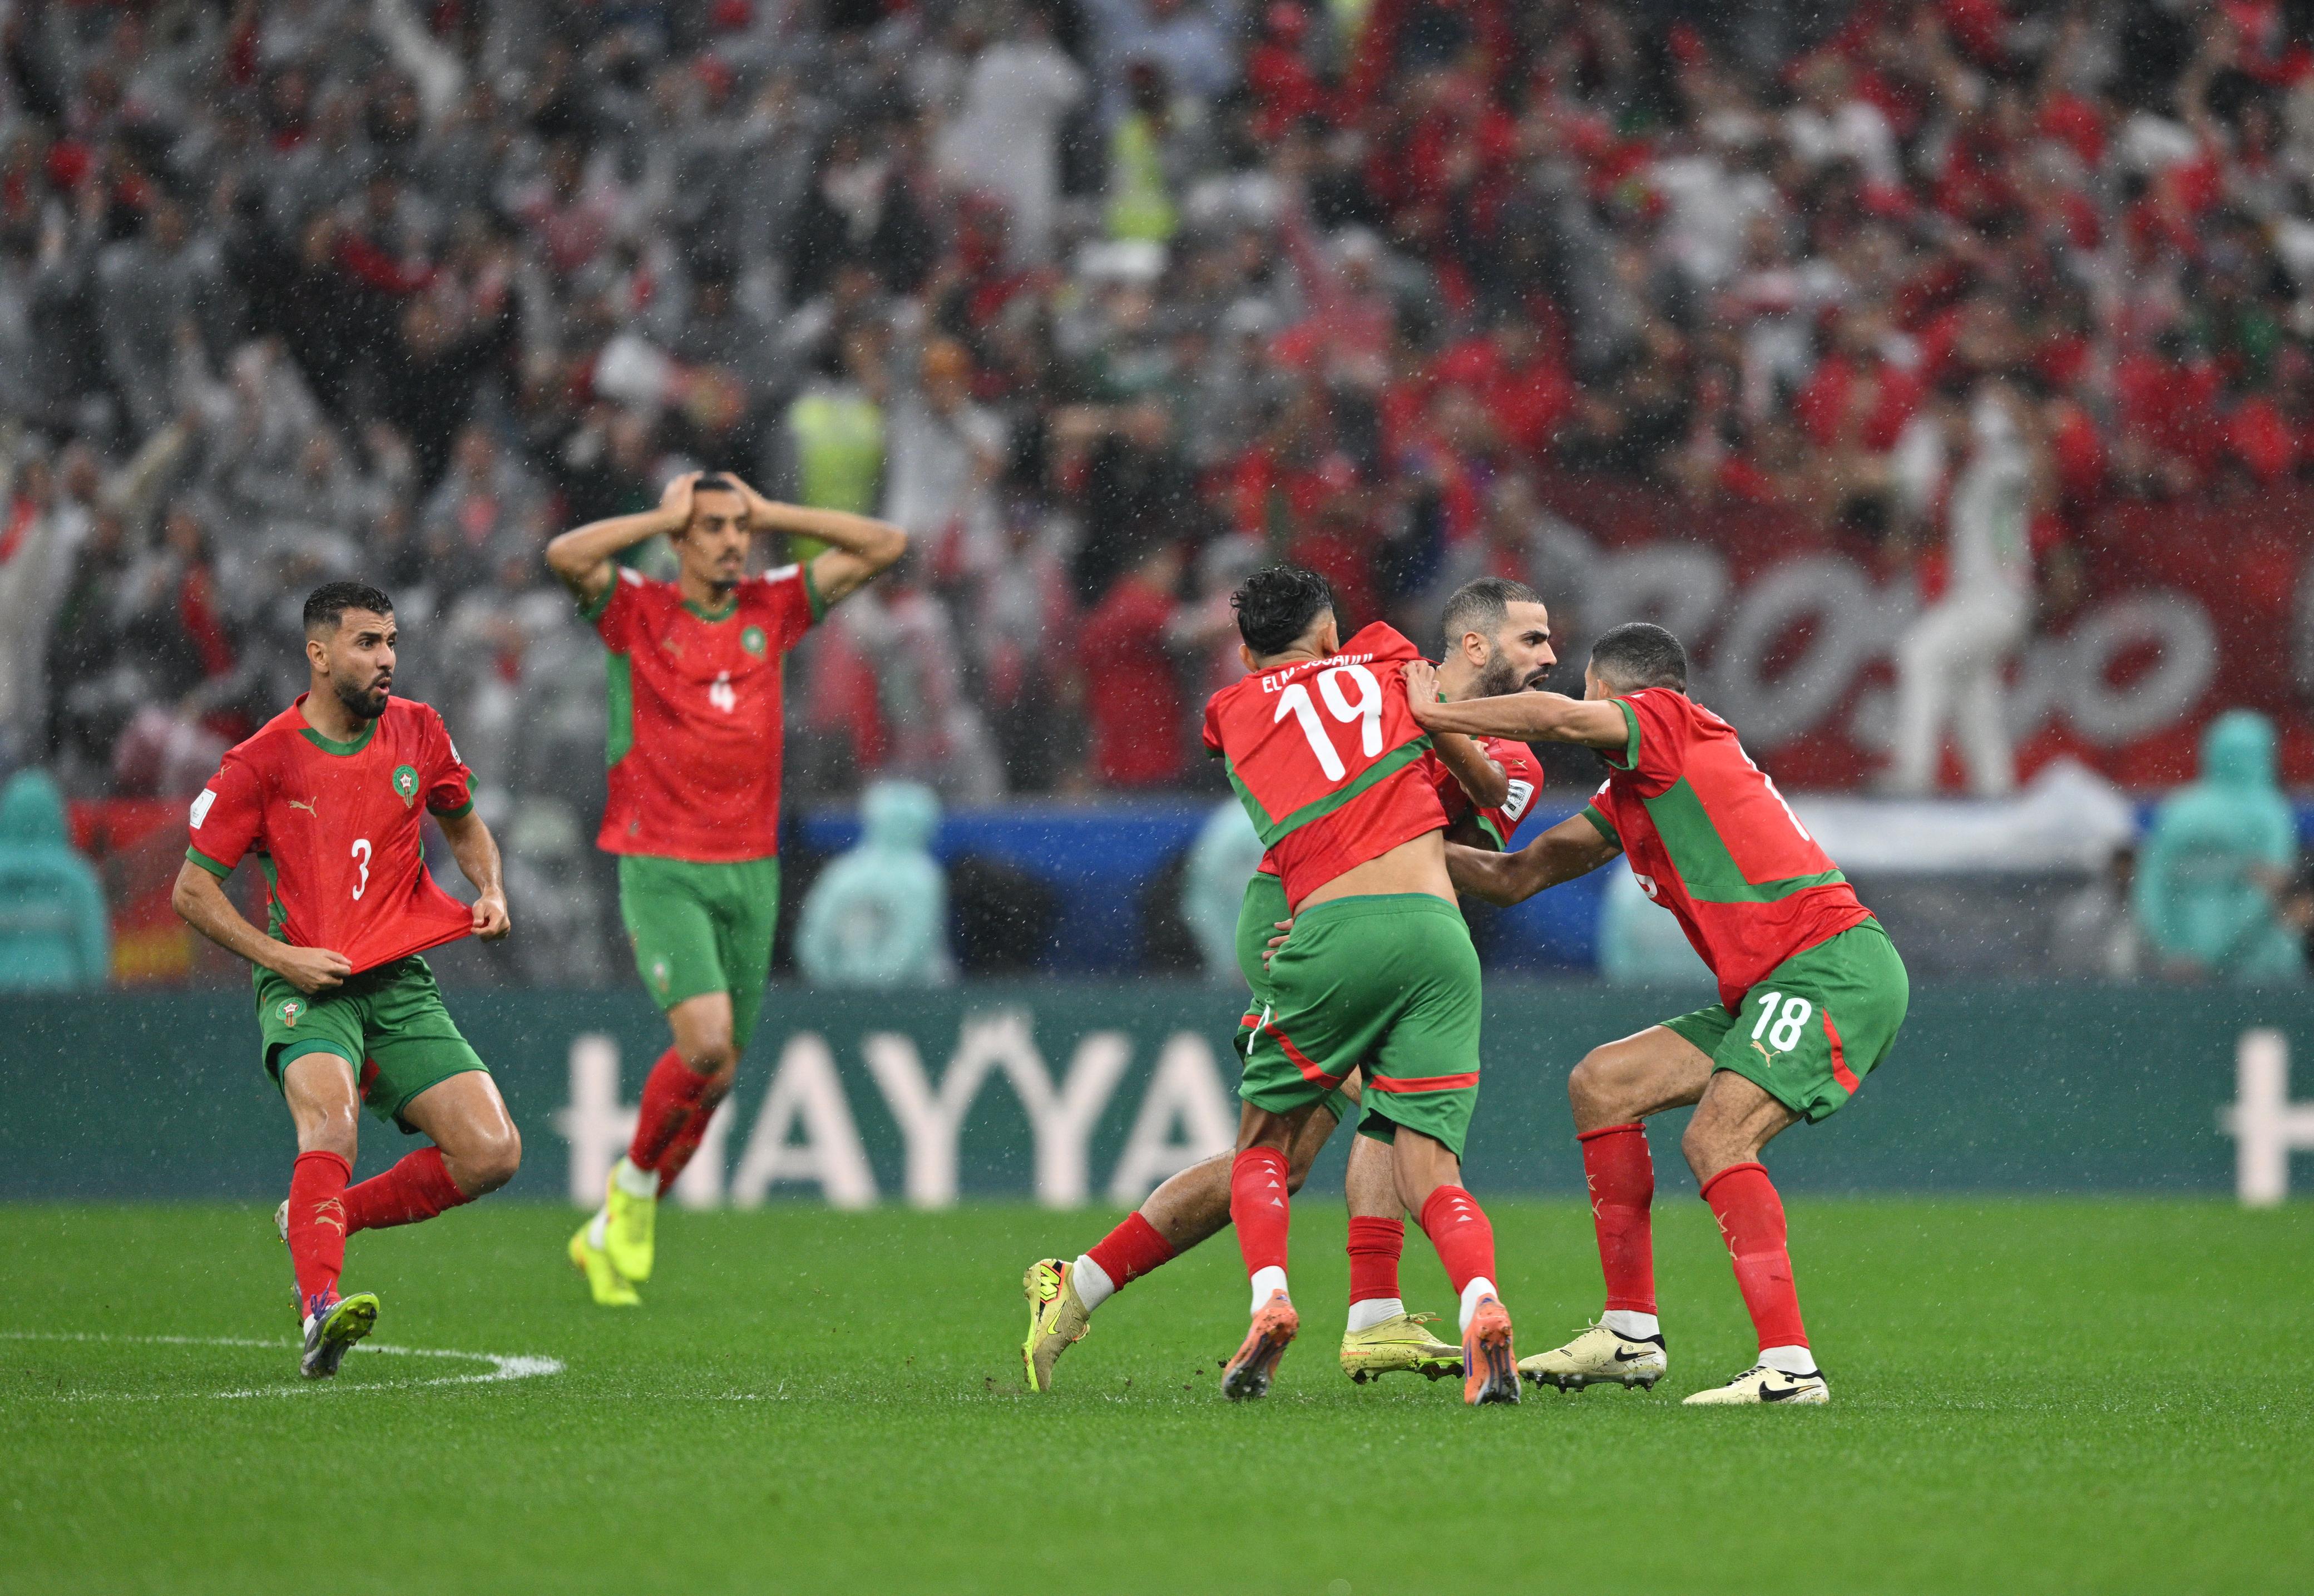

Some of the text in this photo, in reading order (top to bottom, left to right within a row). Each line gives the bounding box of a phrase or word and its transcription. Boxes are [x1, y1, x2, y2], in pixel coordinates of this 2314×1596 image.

[709, 670, 735, 713] 4
[1262, 676, 1282, 693] EL
[1274, 664, 1383, 782] 19
[352, 838, 372, 901] 3
[1751, 992, 1812, 1051] 18
[556, 1010, 1237, 1209] HAYYA
